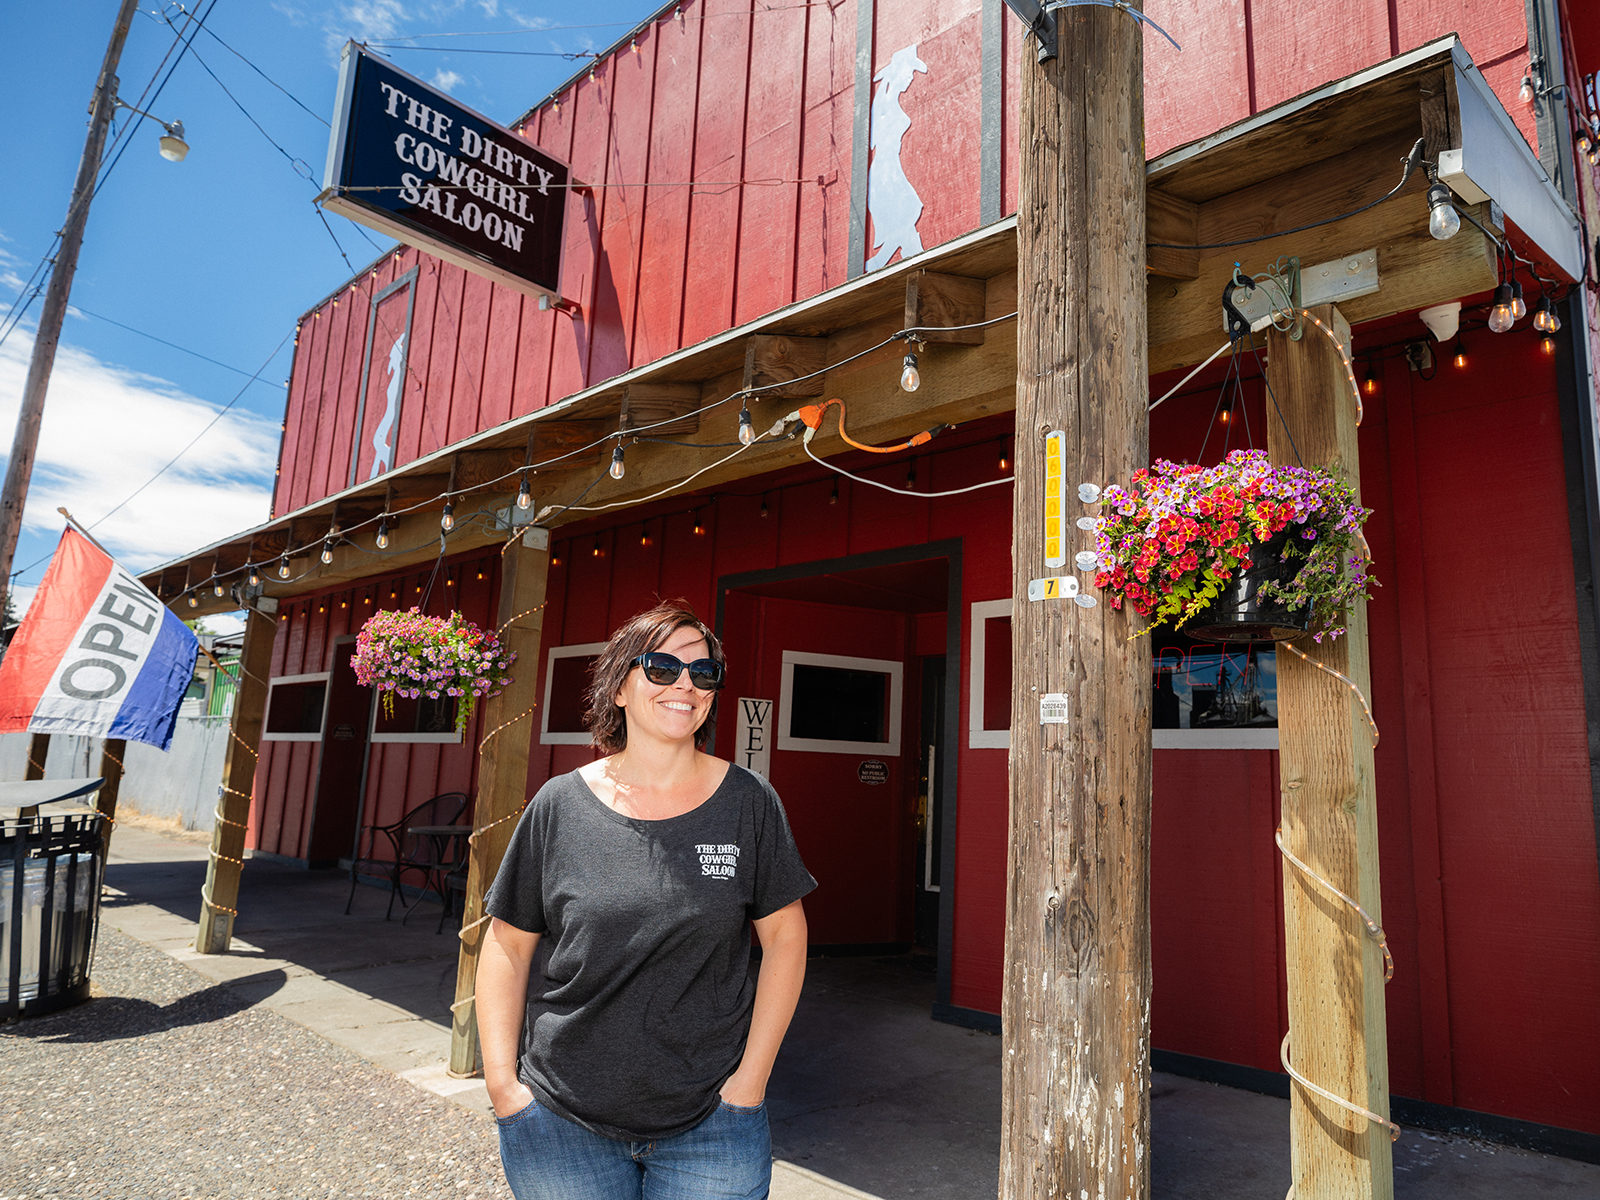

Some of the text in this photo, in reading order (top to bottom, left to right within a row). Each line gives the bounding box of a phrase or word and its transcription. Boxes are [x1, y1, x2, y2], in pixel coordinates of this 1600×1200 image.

[380, 81, 553, 196] THE DIRTY
[394, 133, 534, 223] COWGIRL
[398, 172, 525, 252] SALOON
[1047, 580, 1055, 595] 7
[59, 572, 159, 700] OPEN
[1151, 642, 1252, 689] PEN
[695, 844, 740, 857] THE DIRTY
[699, 854, 737, 866] COWGIRL
[702, 864, 735, 877] SALOON
